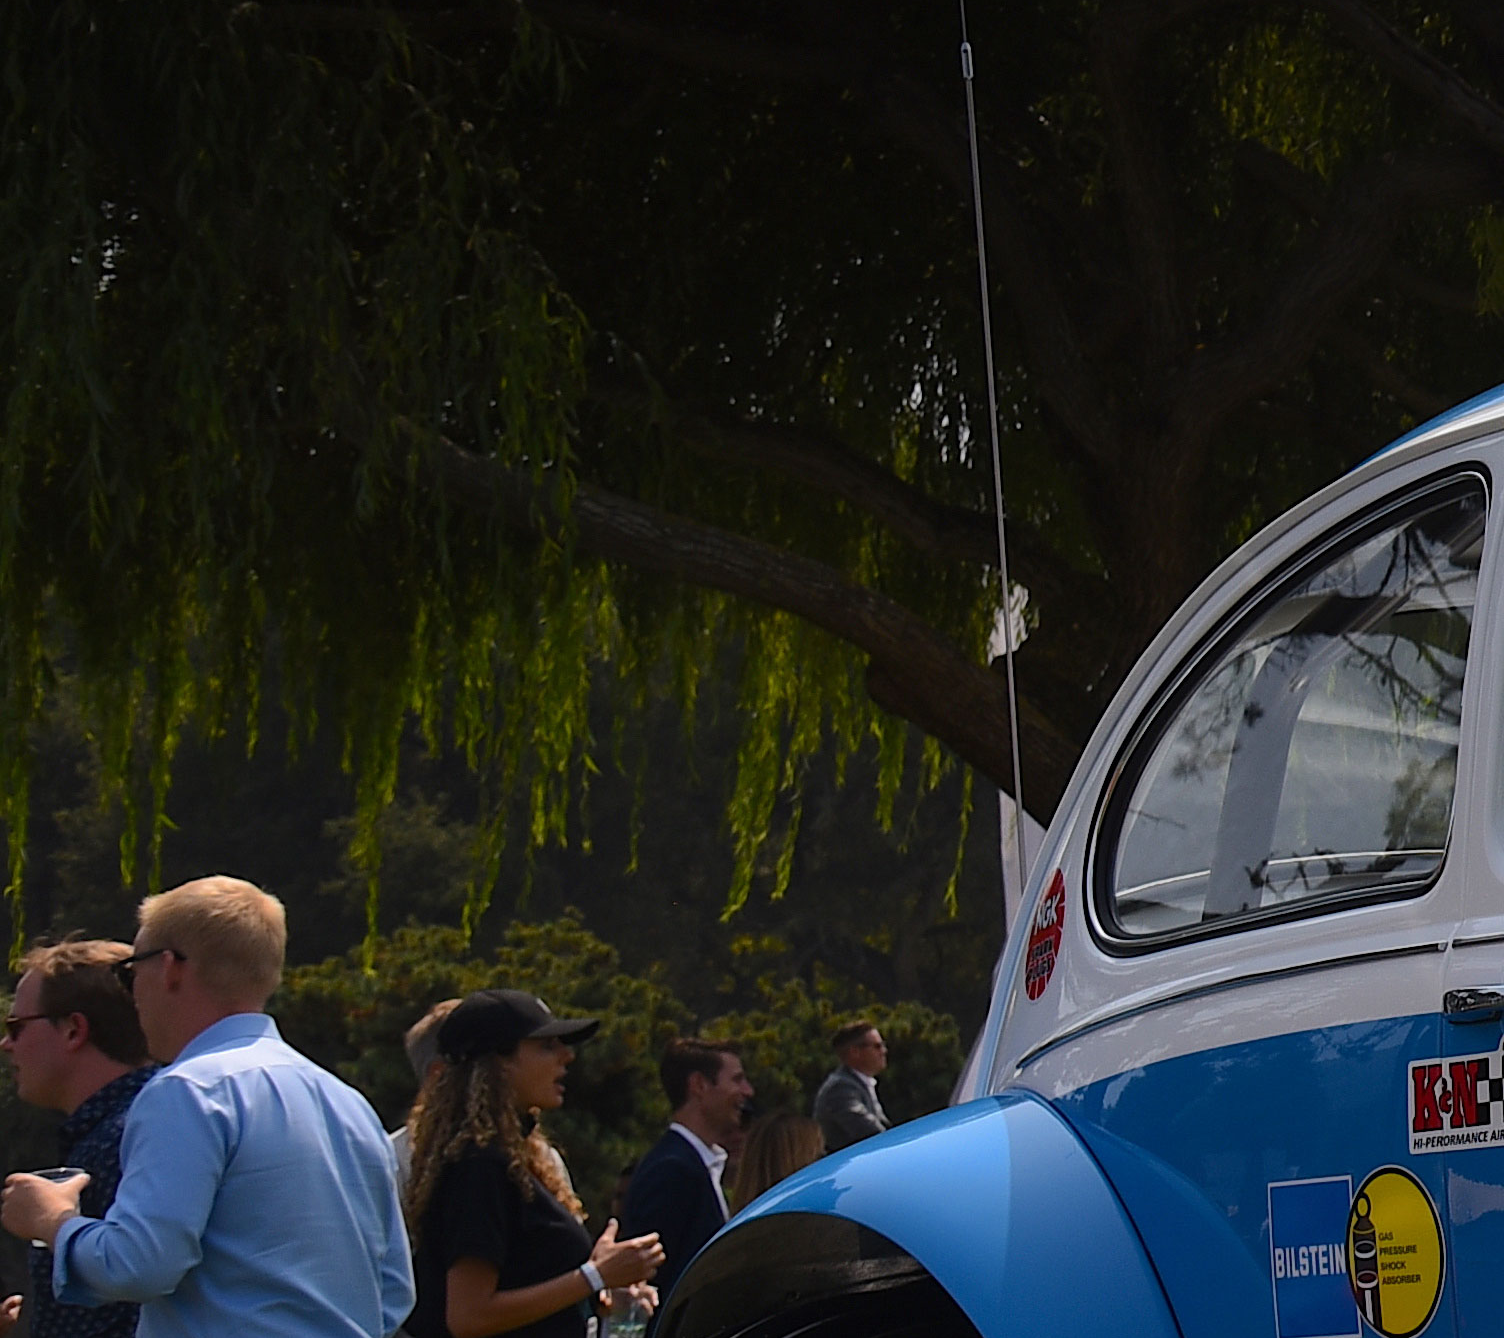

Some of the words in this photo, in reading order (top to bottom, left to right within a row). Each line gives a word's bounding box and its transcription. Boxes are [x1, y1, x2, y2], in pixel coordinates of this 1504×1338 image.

[1034, 892, 1061, 935] NGK
[1412, 1061, 1480, 1133] K&N
[1378, 1231, 1394, 1241] GAS
[1379, 1244, 1418, 1256] PRESSURE
[1274, 1242, 1347, 1279] BILSTEIN
[1380, 1261, 1407, 1271] SHOCK
[1381, 1274, 1422, 1286] ABSORBER
